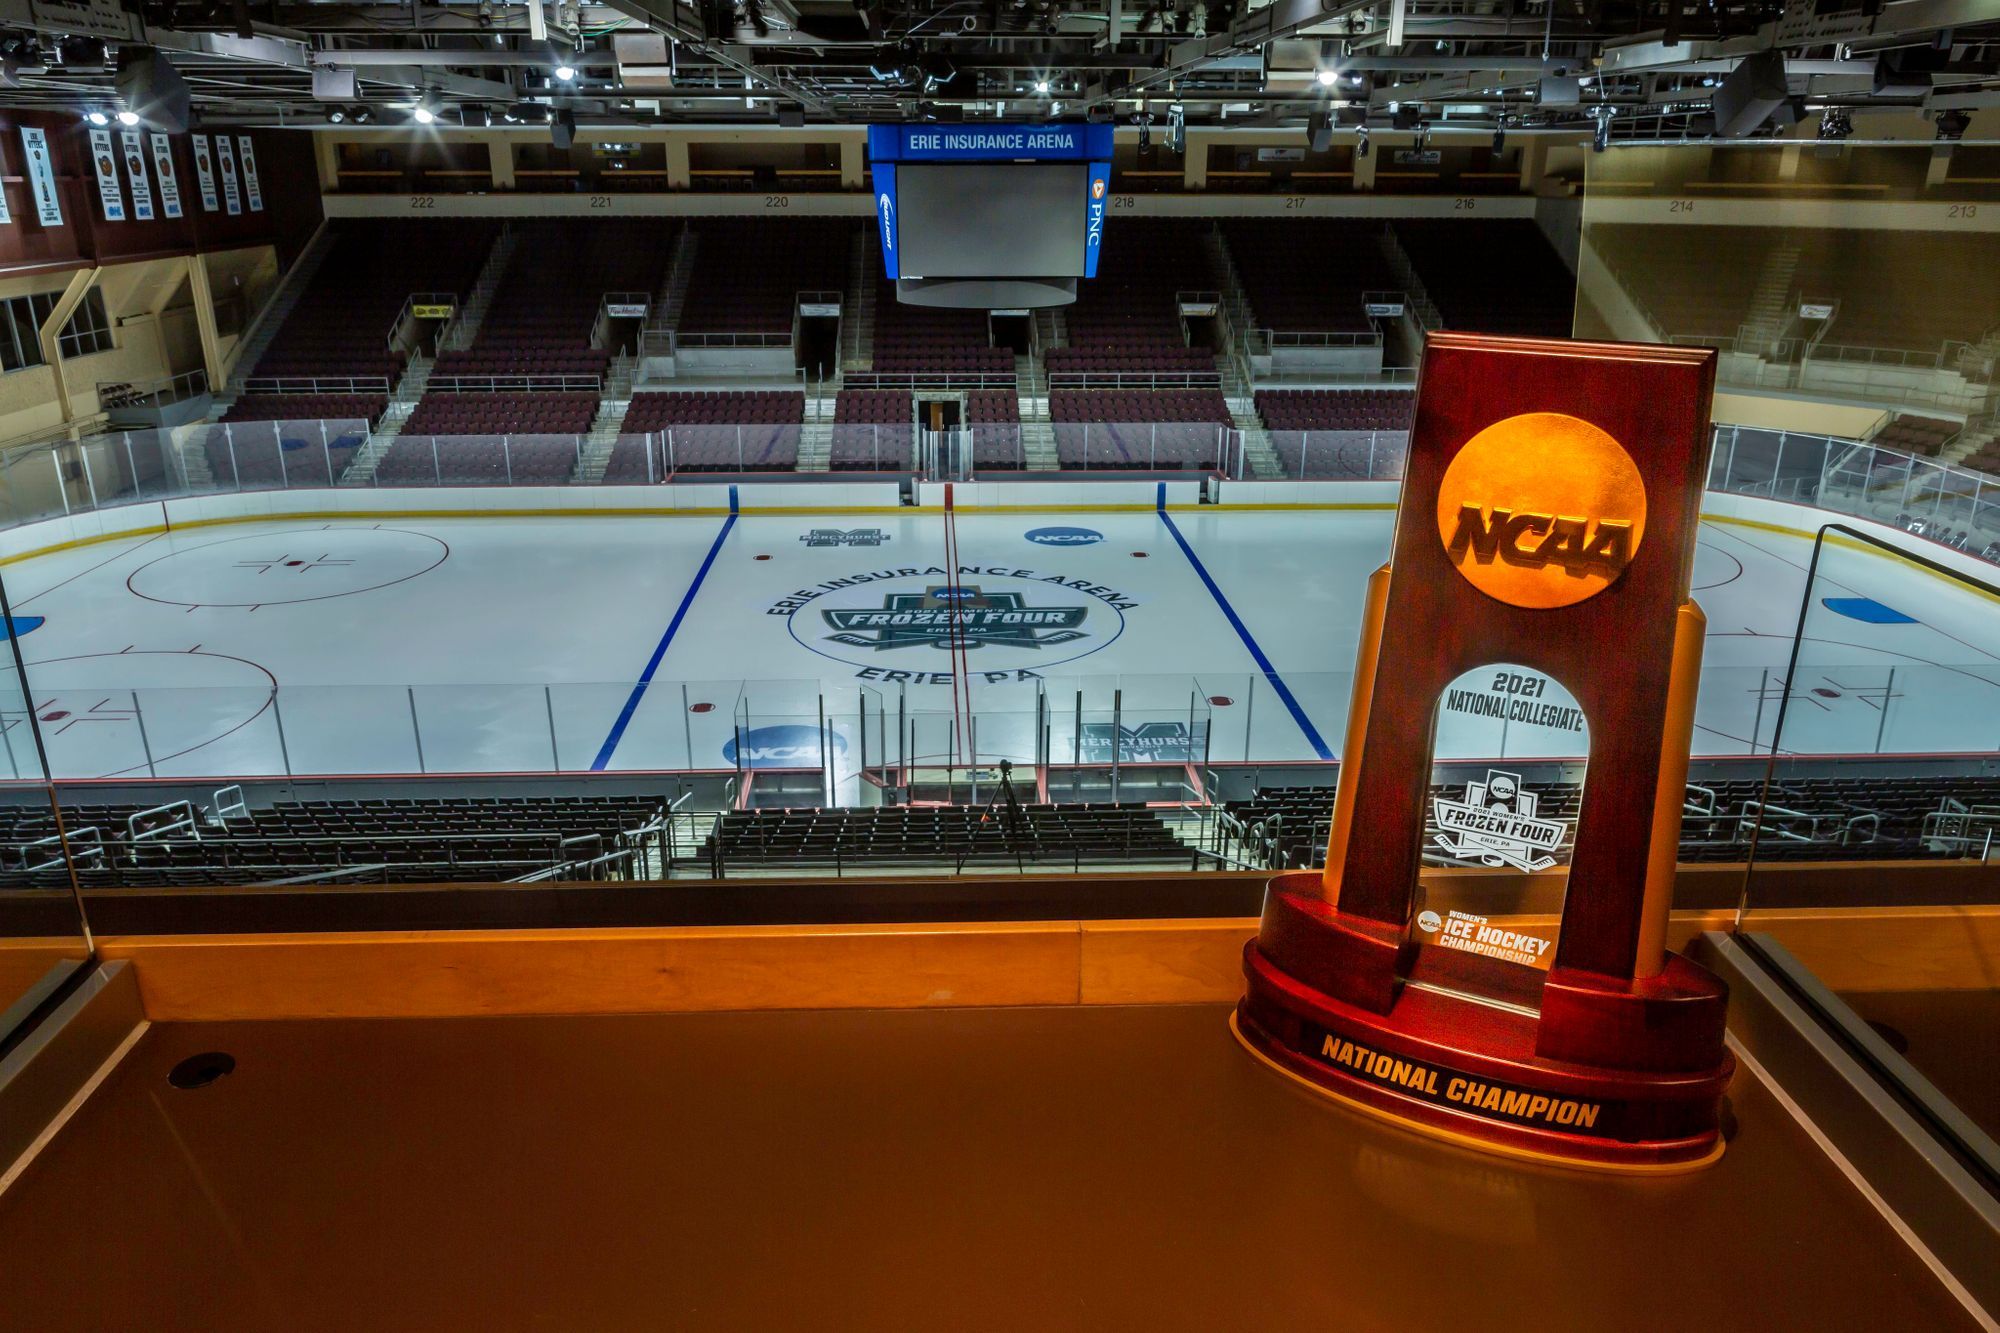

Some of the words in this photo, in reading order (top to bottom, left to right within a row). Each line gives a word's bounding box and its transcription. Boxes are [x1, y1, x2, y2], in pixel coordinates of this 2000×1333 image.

[910, 135, 941, 149] ERIE
[945, 134, 1023, 149] INSURANCE
[1027, 134, 1074, 149] ARENA
[411, 197, 434, 208] 222
[590, 197, 612, 208] 221
[766, 197, 789, 208] 220
[1115, 197, 1135, 208] 218
[1286, 197, 1306, 209] 217
[1455, 198, 1475, 210] 216
[1670, 200, 1694, 213] 214
[1948, 205, 1977, 219] 213
[1088, 203, 1103, 247] PNC
[1448, 501, 1634, 568] NCAA
[766, 589, 823, 616] ERIE
[817, 566, 1035, 591] INSURANCE
[1042, 575, 1139, 611] ARENA
[848, 612, 976, 626] FROZEN
[983, 612, 1066, 625] FOUR
[855, 666, 954, 685] ERIE
[984, 669, 1045, 684] PA
[1491, 672, 1547, 698] 2021
[1446, 689, 1506, 719] NATIONAL
[1509, 699, 1584, 732] COLLEGIATE
[1492, 786, 1514, 795] NCAA
[1473, 807, 1491, 816] 2021
[1492, 810, 1526, 820] WOMEN'S
[1445, 809, 1509, 834] FROZEN
[1510, 822, 1555, 843] FOUR
[1420, 919, 1440, 928] NCAA
[1449, 910, 1487, 924] WOMEN'S
[1444, 919, 1475, 938] ICE
[1476, 926, 1551, 955] HOCKEY
[1440, 935, 1536, 964] CHAMPIONSHIP
[1321, 1034, 1438, 1095] NATIONAL
[1446, 1077, 1600, 1128] CHAMPION
